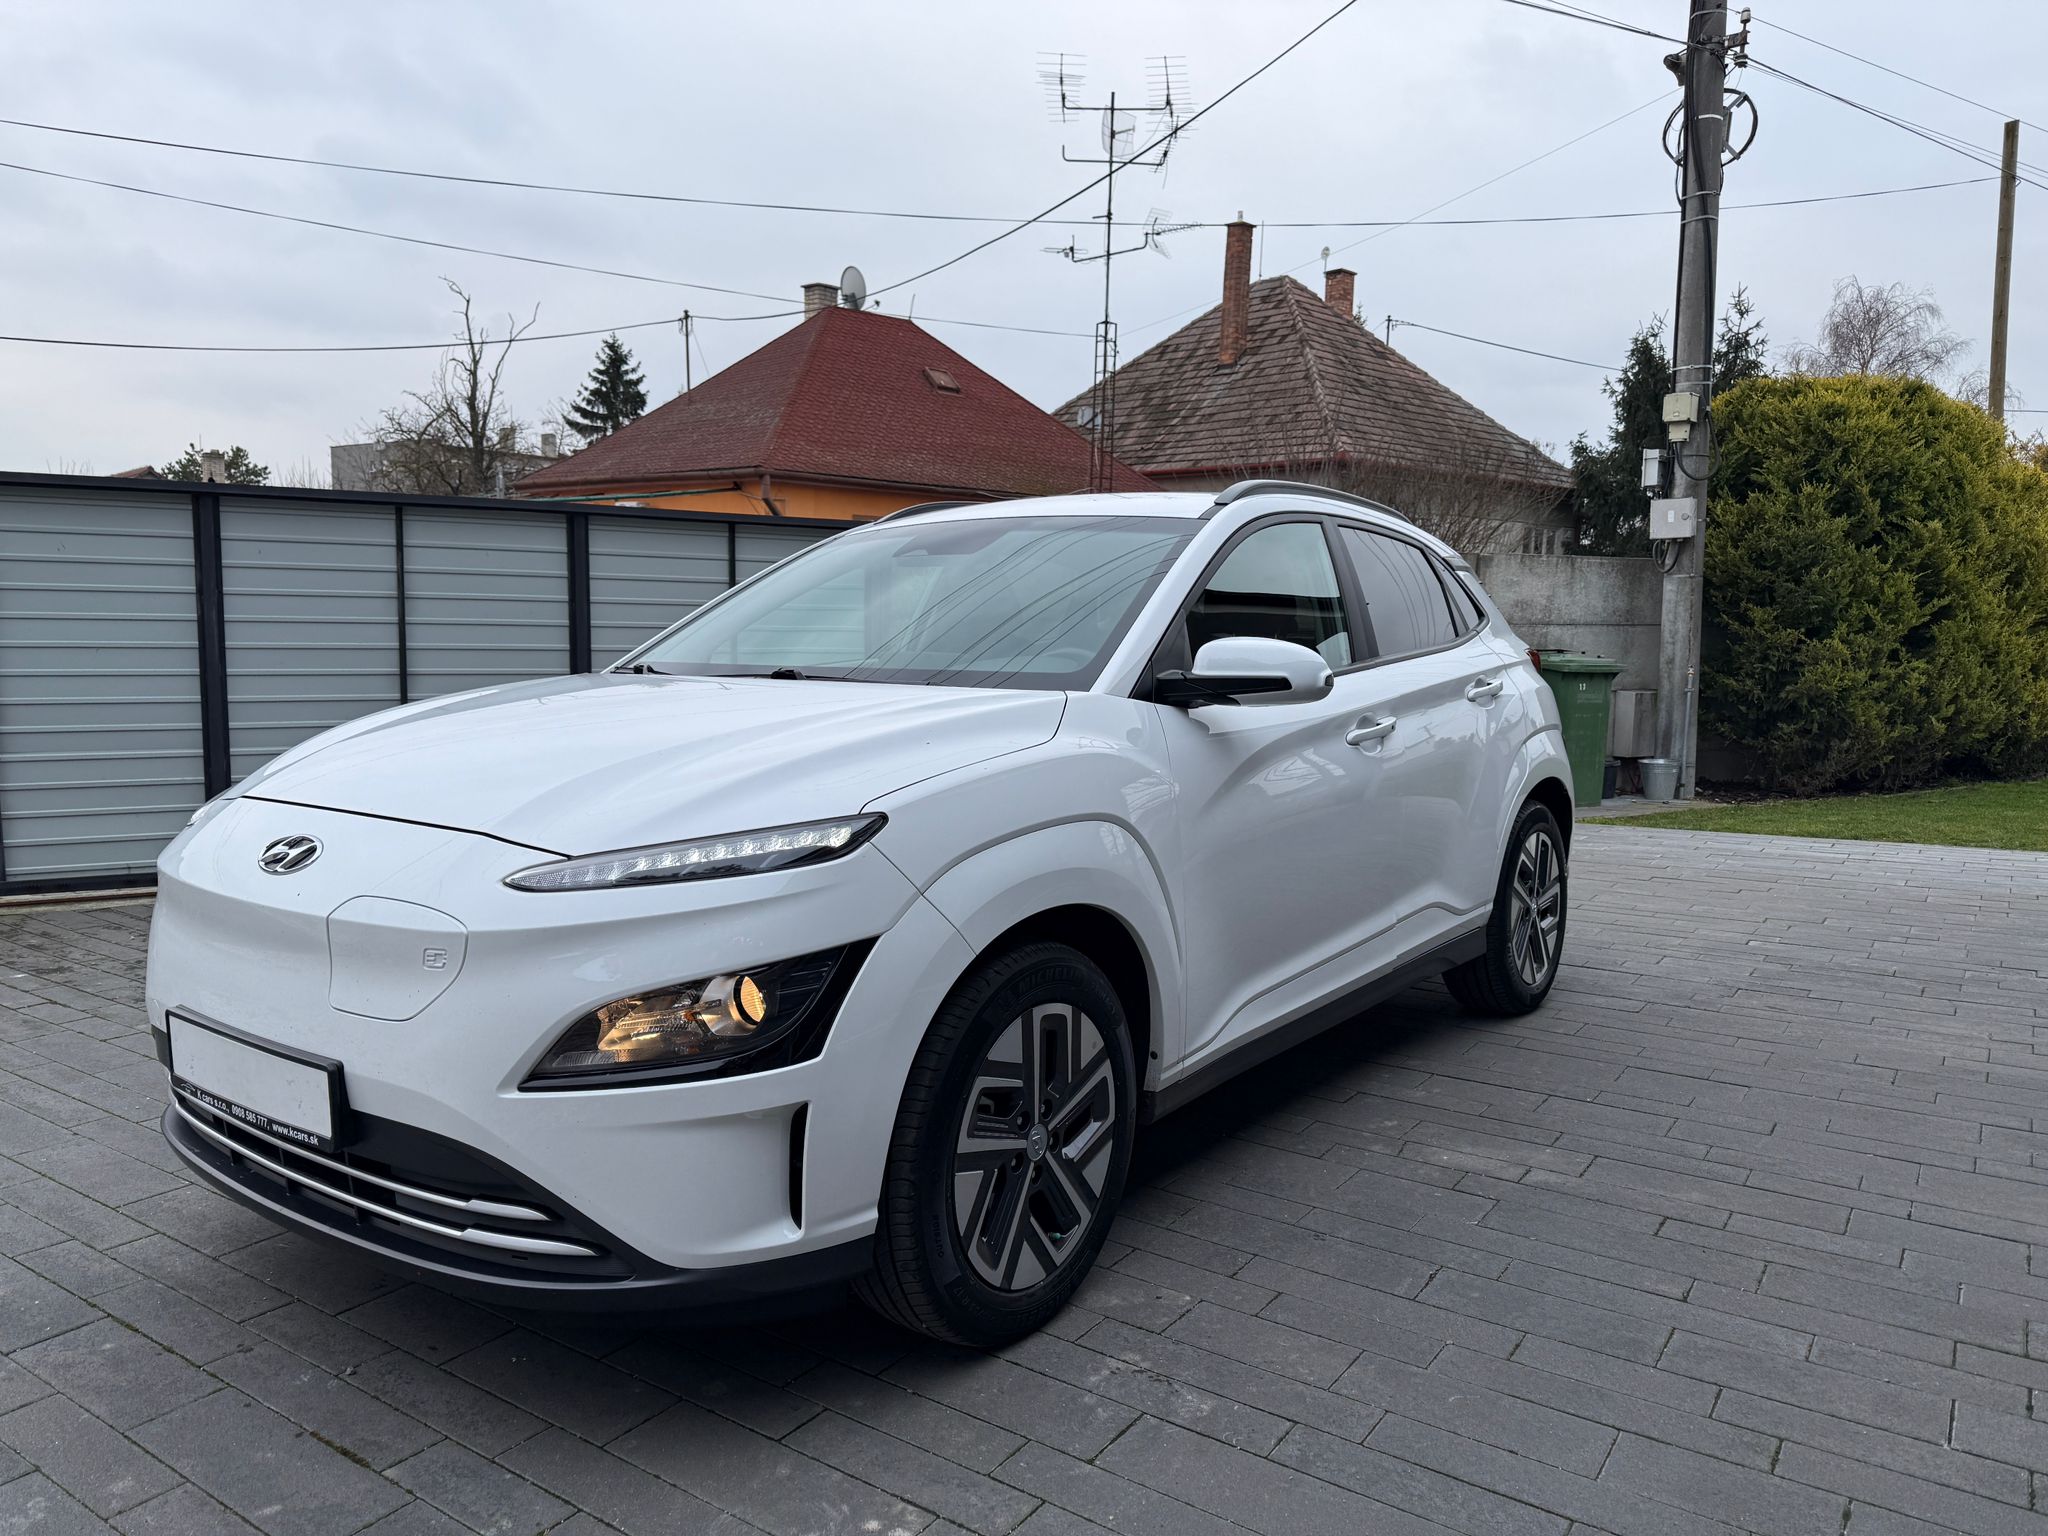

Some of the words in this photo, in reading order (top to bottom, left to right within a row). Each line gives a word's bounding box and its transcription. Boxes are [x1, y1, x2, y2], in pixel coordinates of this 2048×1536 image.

[196, 1089, 202, 1099] K
[202, 1093, 214, 1105] cars
[231, 1104, 246, 1119] 0908
[245, 1111, 256, 1123] 585
[271, 1123, 319, 1146] www.kcars.sk
